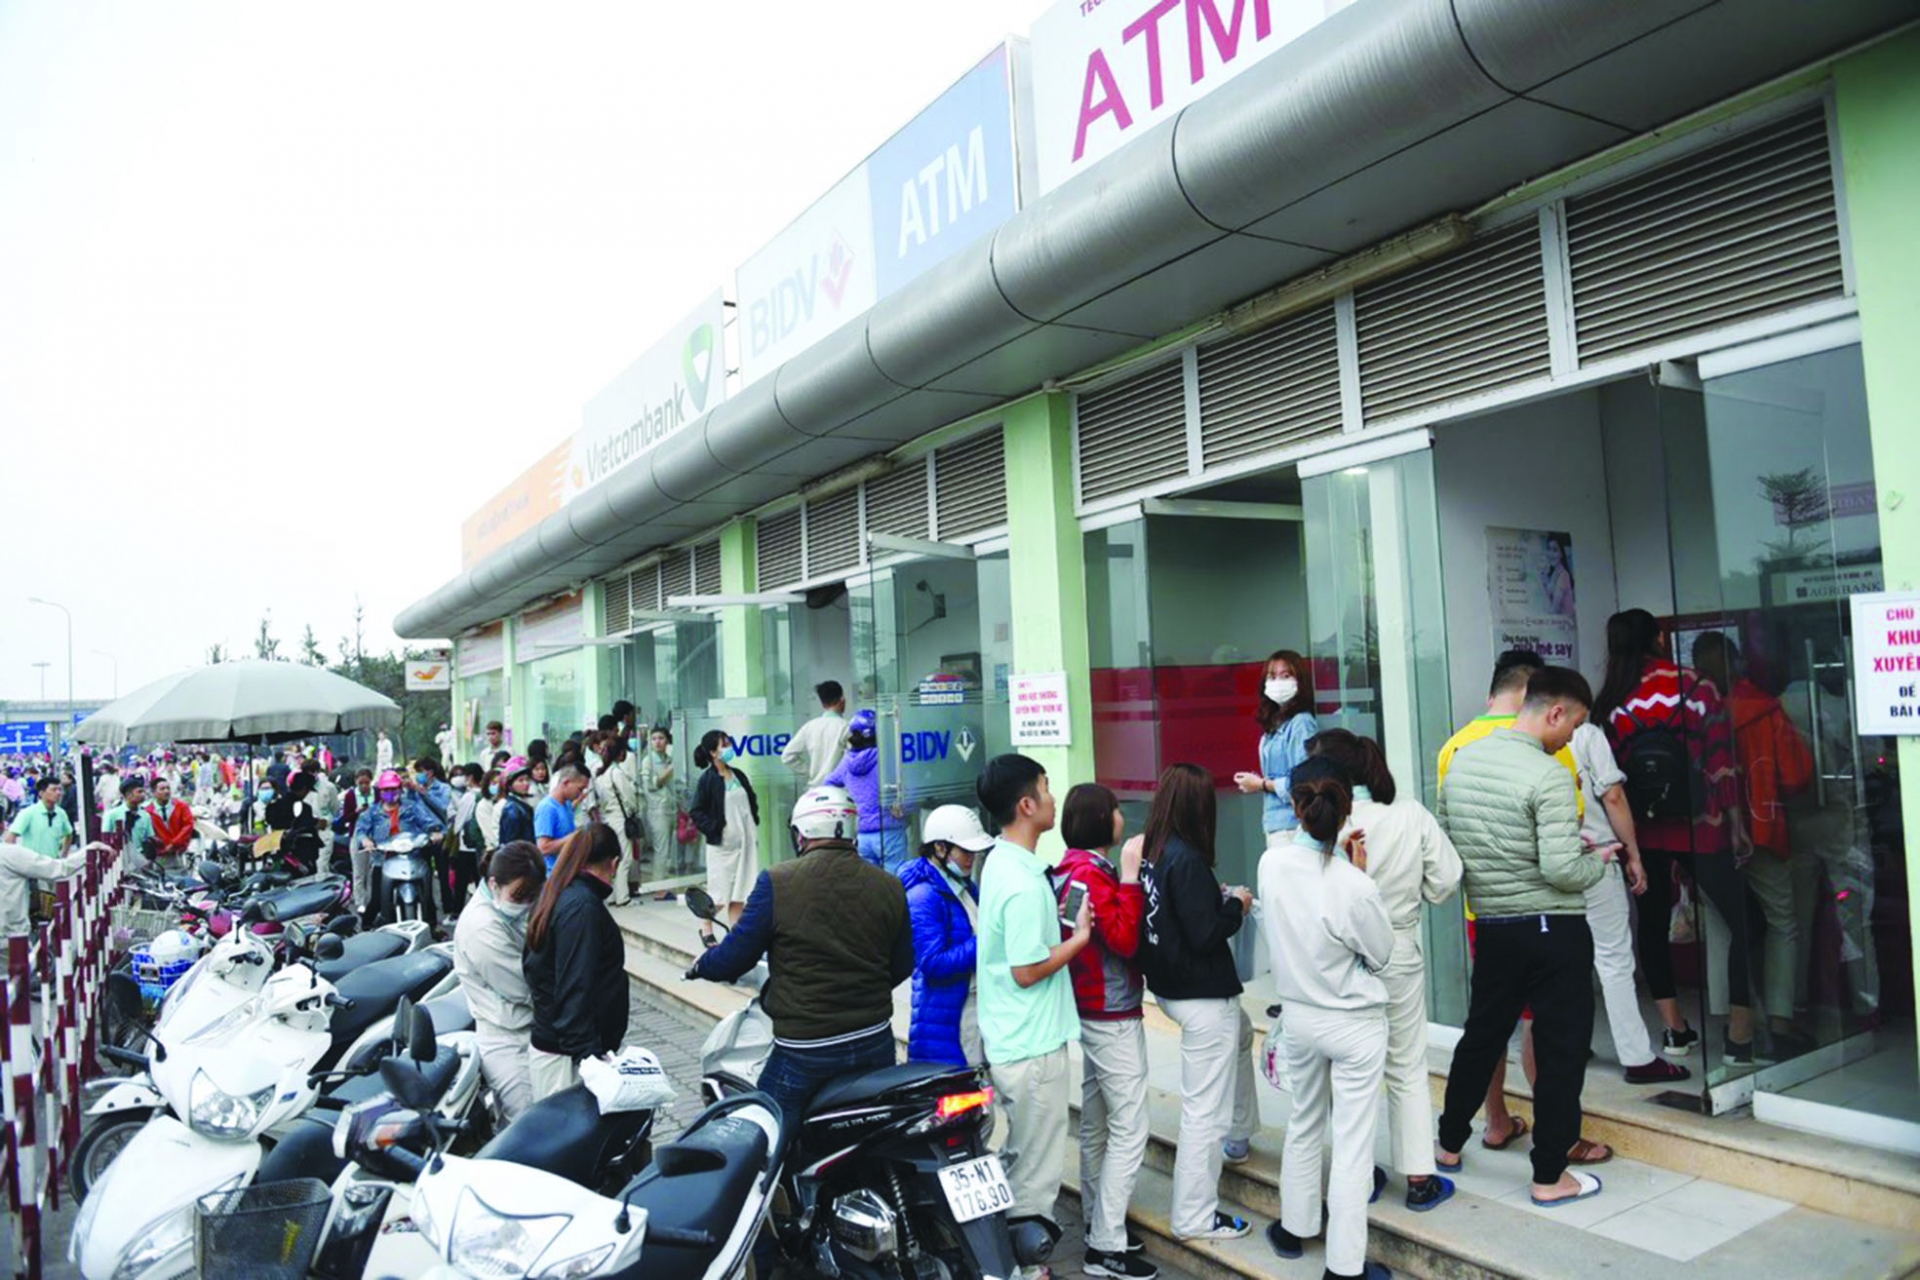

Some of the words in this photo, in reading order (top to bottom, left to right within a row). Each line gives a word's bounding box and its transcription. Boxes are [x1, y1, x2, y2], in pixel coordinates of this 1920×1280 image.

[1072, 0, 1271, 163] ATM
[898, 124, 988, 260] ATM
[749, 253, 817, 359] BIDV
[585, 382, 686, 483] Vietcombank
[1810, 581, 1882, 599] AGRIBANK
[901, 730, 950, 764] BIDV
[949, 1161, 995, 1191] 35-N1
[954, 1183, 1011, 1218] 176.90
